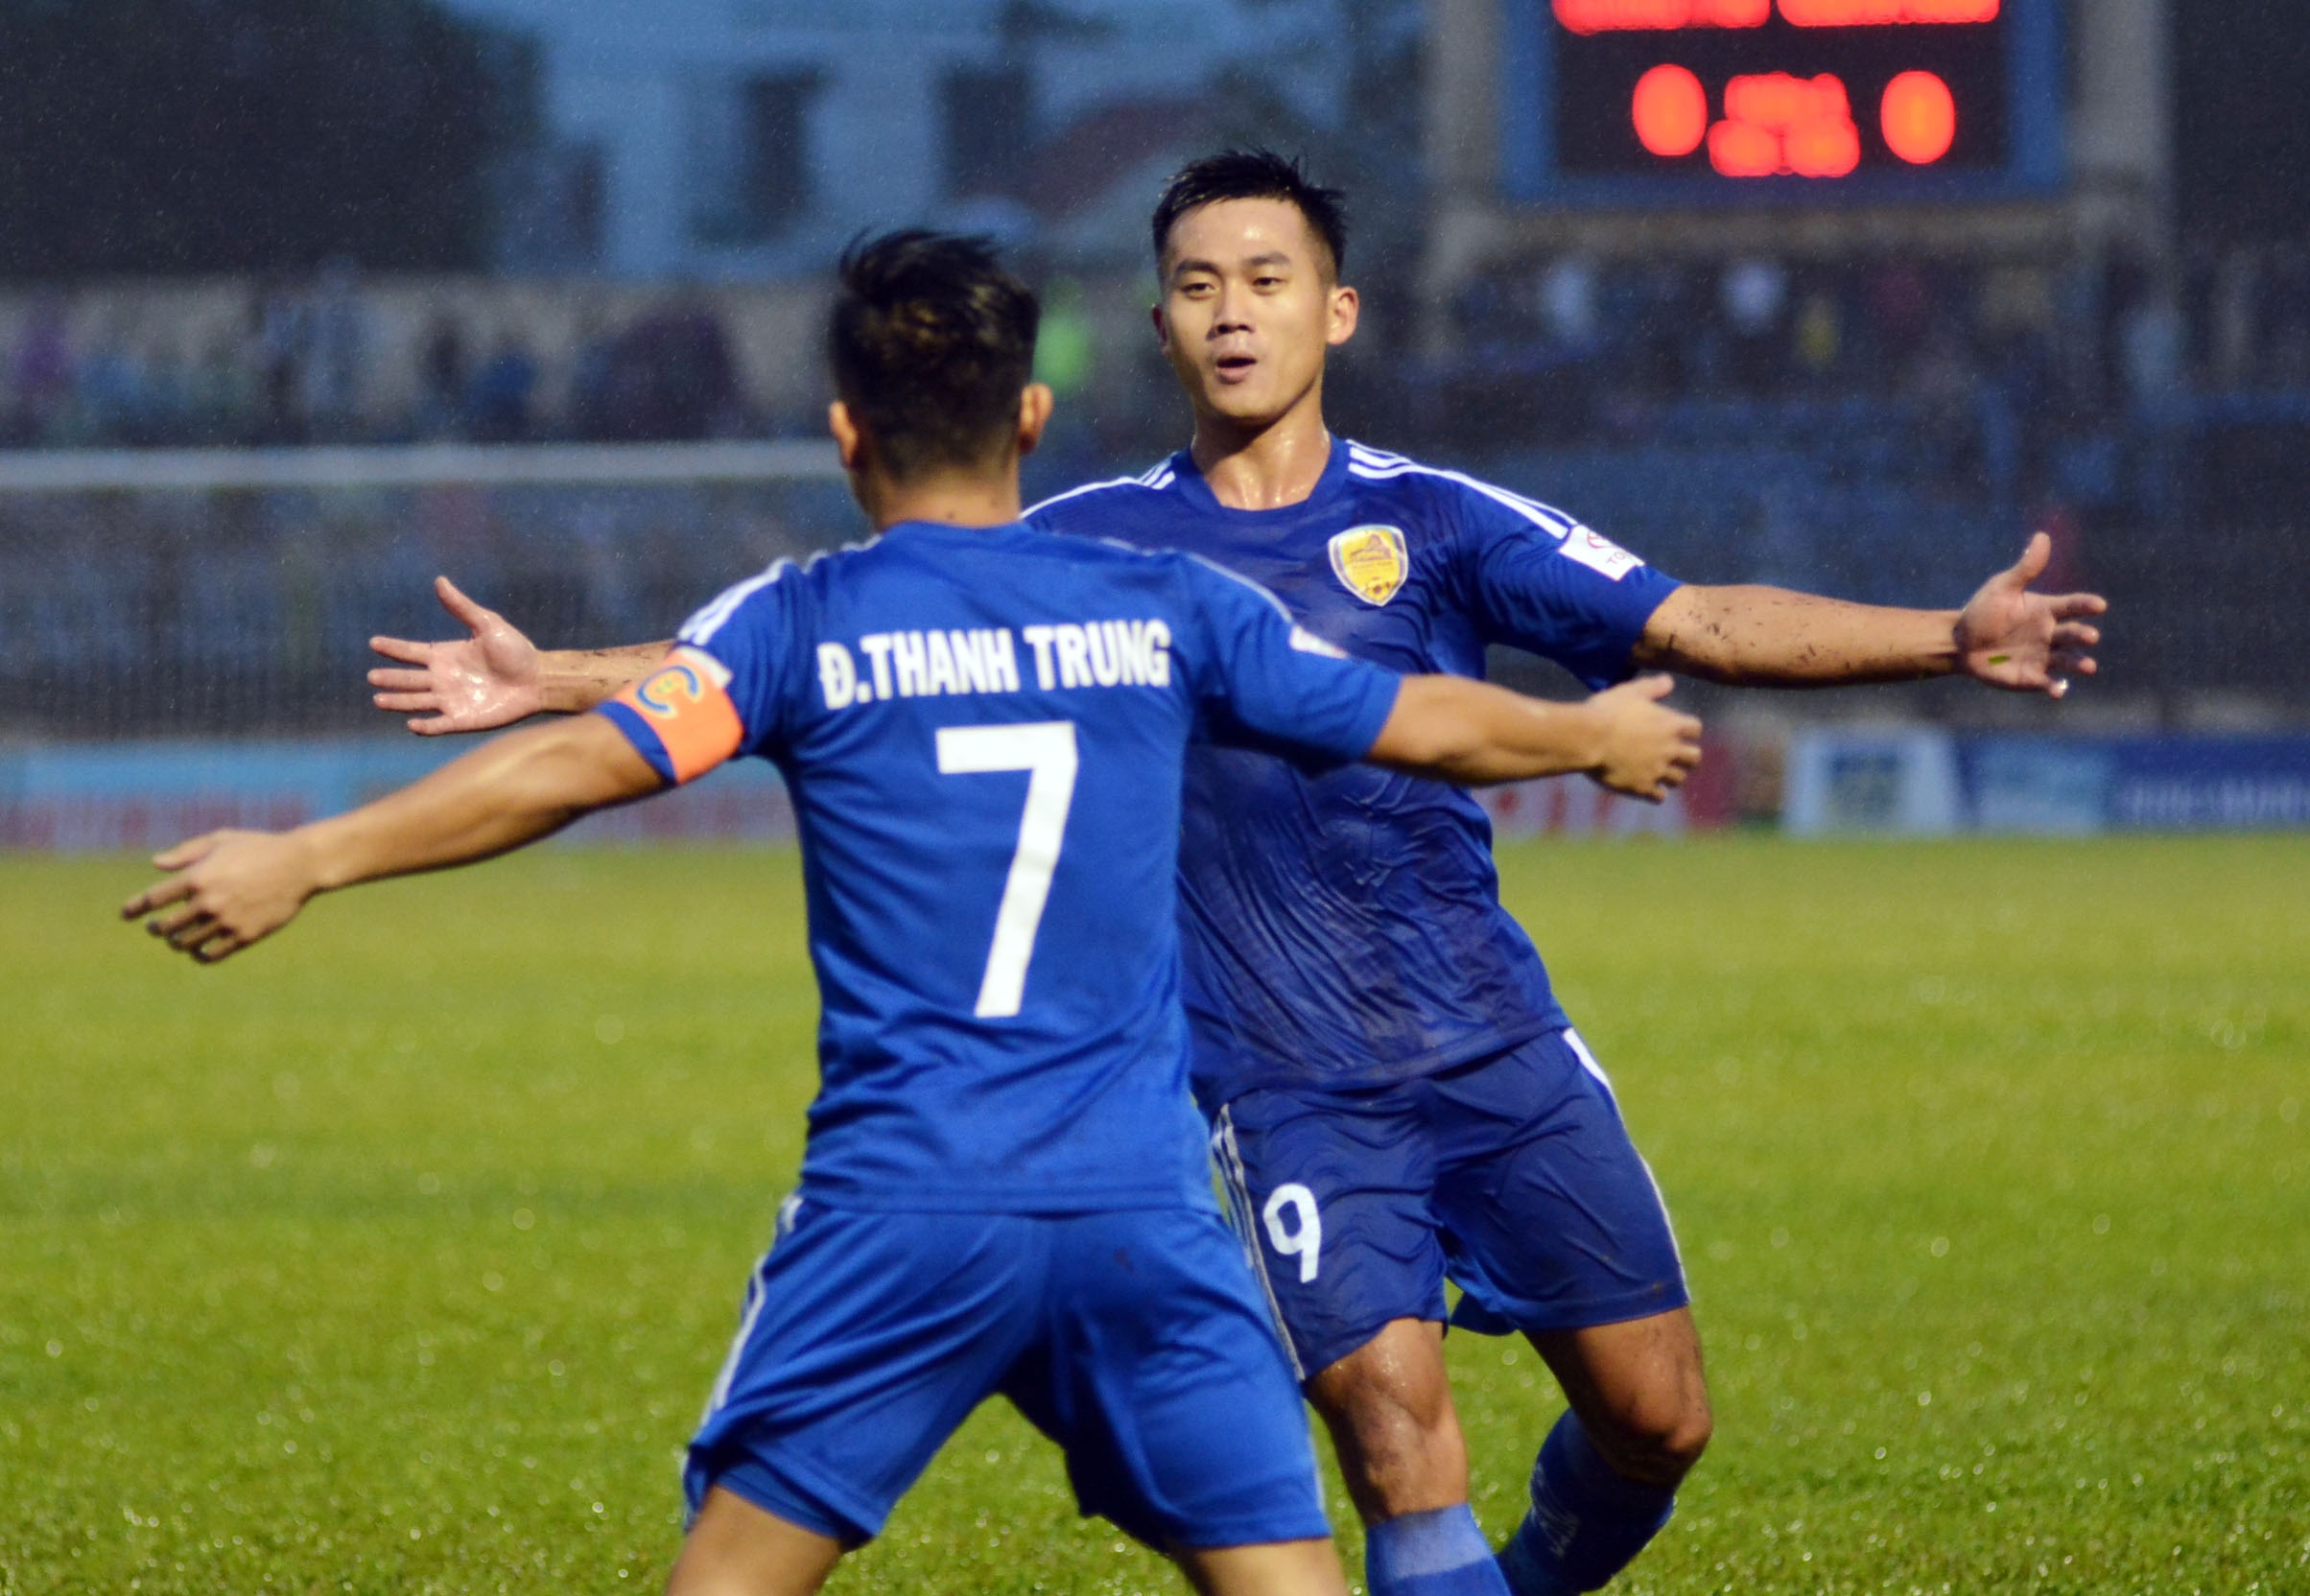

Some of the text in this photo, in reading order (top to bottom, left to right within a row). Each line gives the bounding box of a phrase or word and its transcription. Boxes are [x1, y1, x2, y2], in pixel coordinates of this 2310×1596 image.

[817, 620, 1170, 710] Đ.THANH TRUNG
[936, 721, 1077, 1018] 7
[1263, 1184, 1321, 1283] 9
